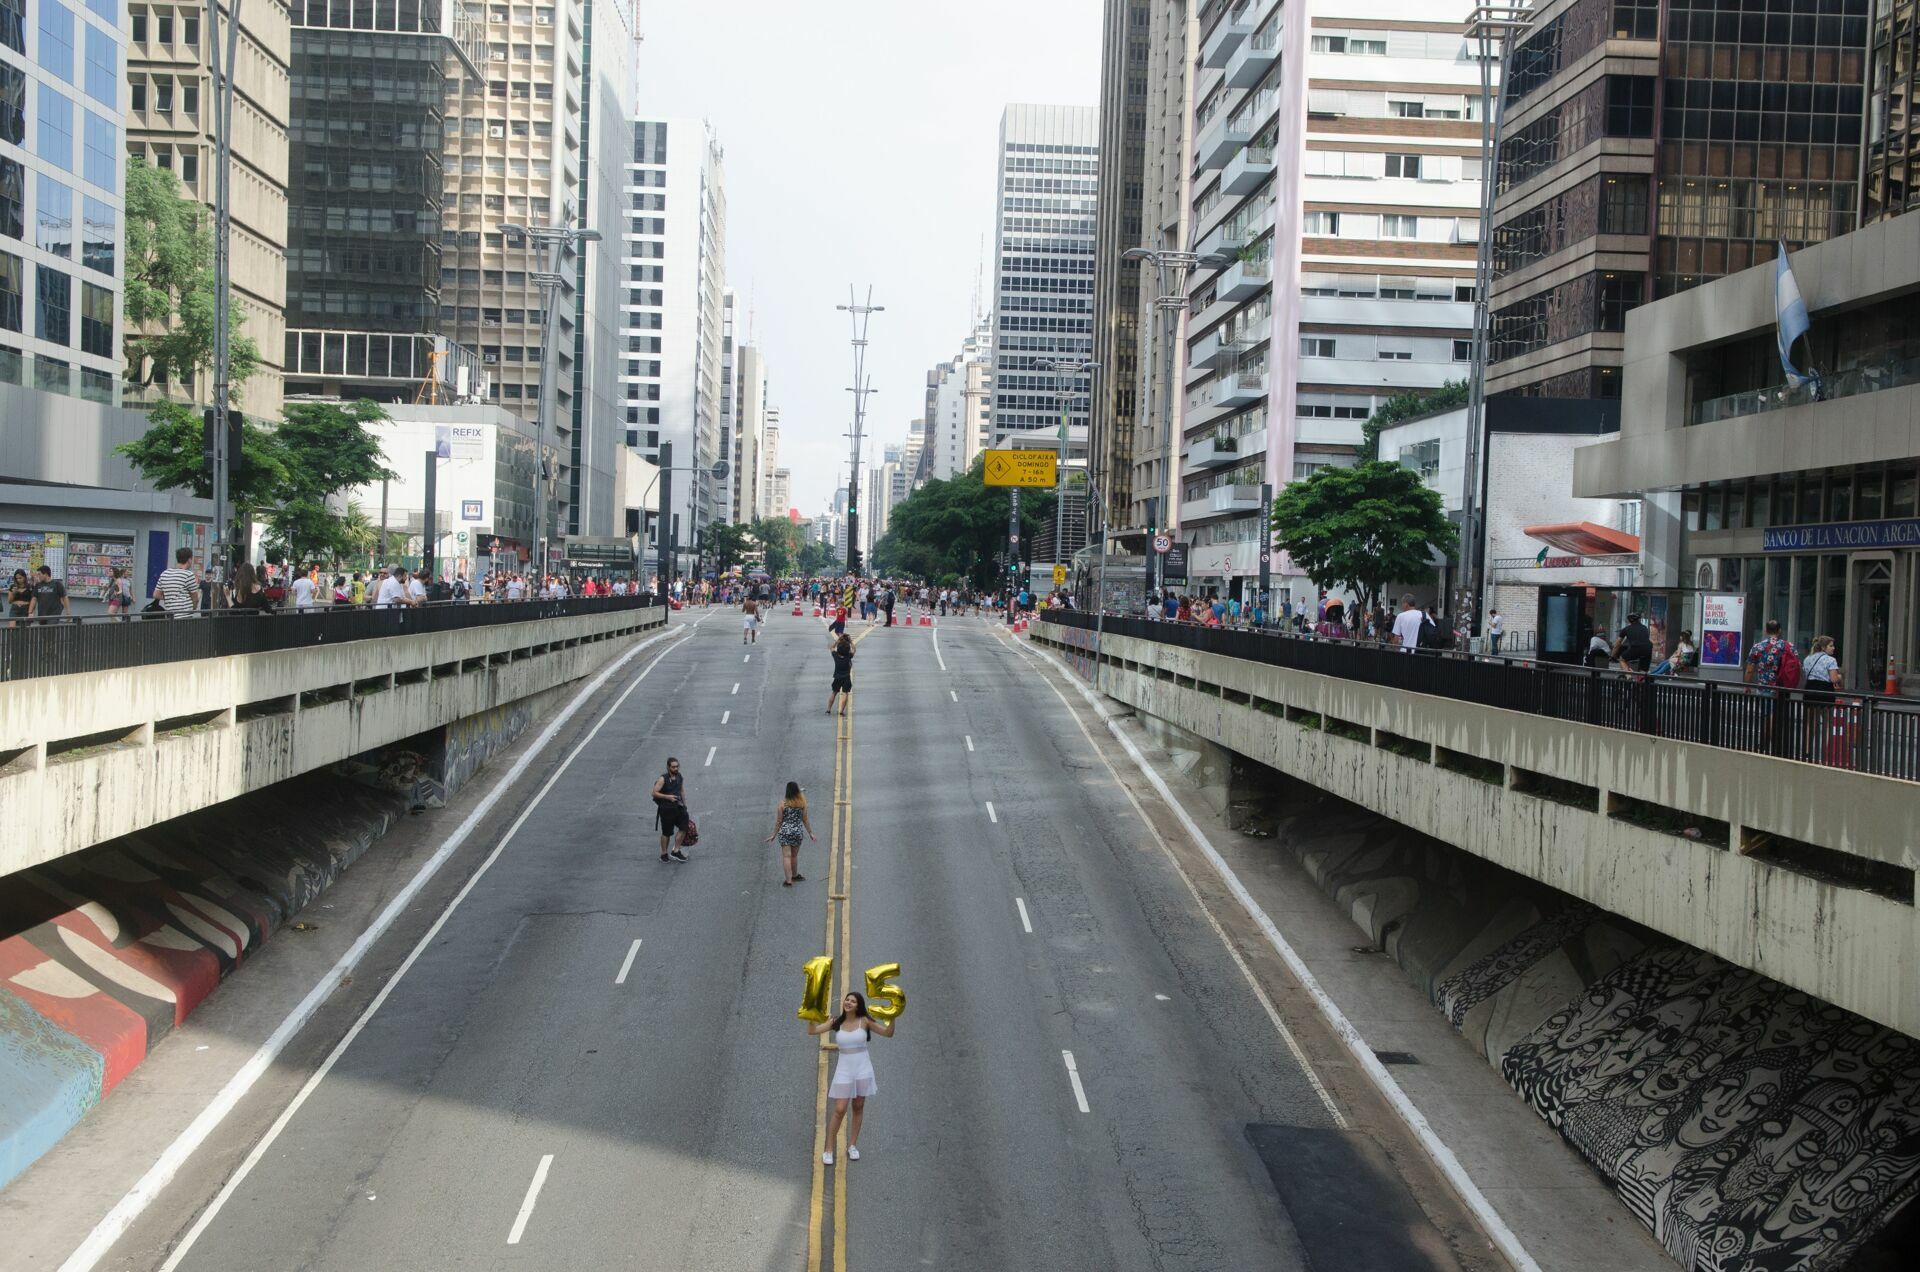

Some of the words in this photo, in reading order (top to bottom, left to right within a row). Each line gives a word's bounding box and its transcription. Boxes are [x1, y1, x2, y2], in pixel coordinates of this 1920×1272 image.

[452, 428, 482, 437] REFIX
[1764, 530, 1798, 547] BANCO
[1800, 529, 1813, 545] DE
[1817, 528, 1831, 545] LA
[1834, 525, 1879, 545] NACION
[1156, 538, 1168, 546] 50
